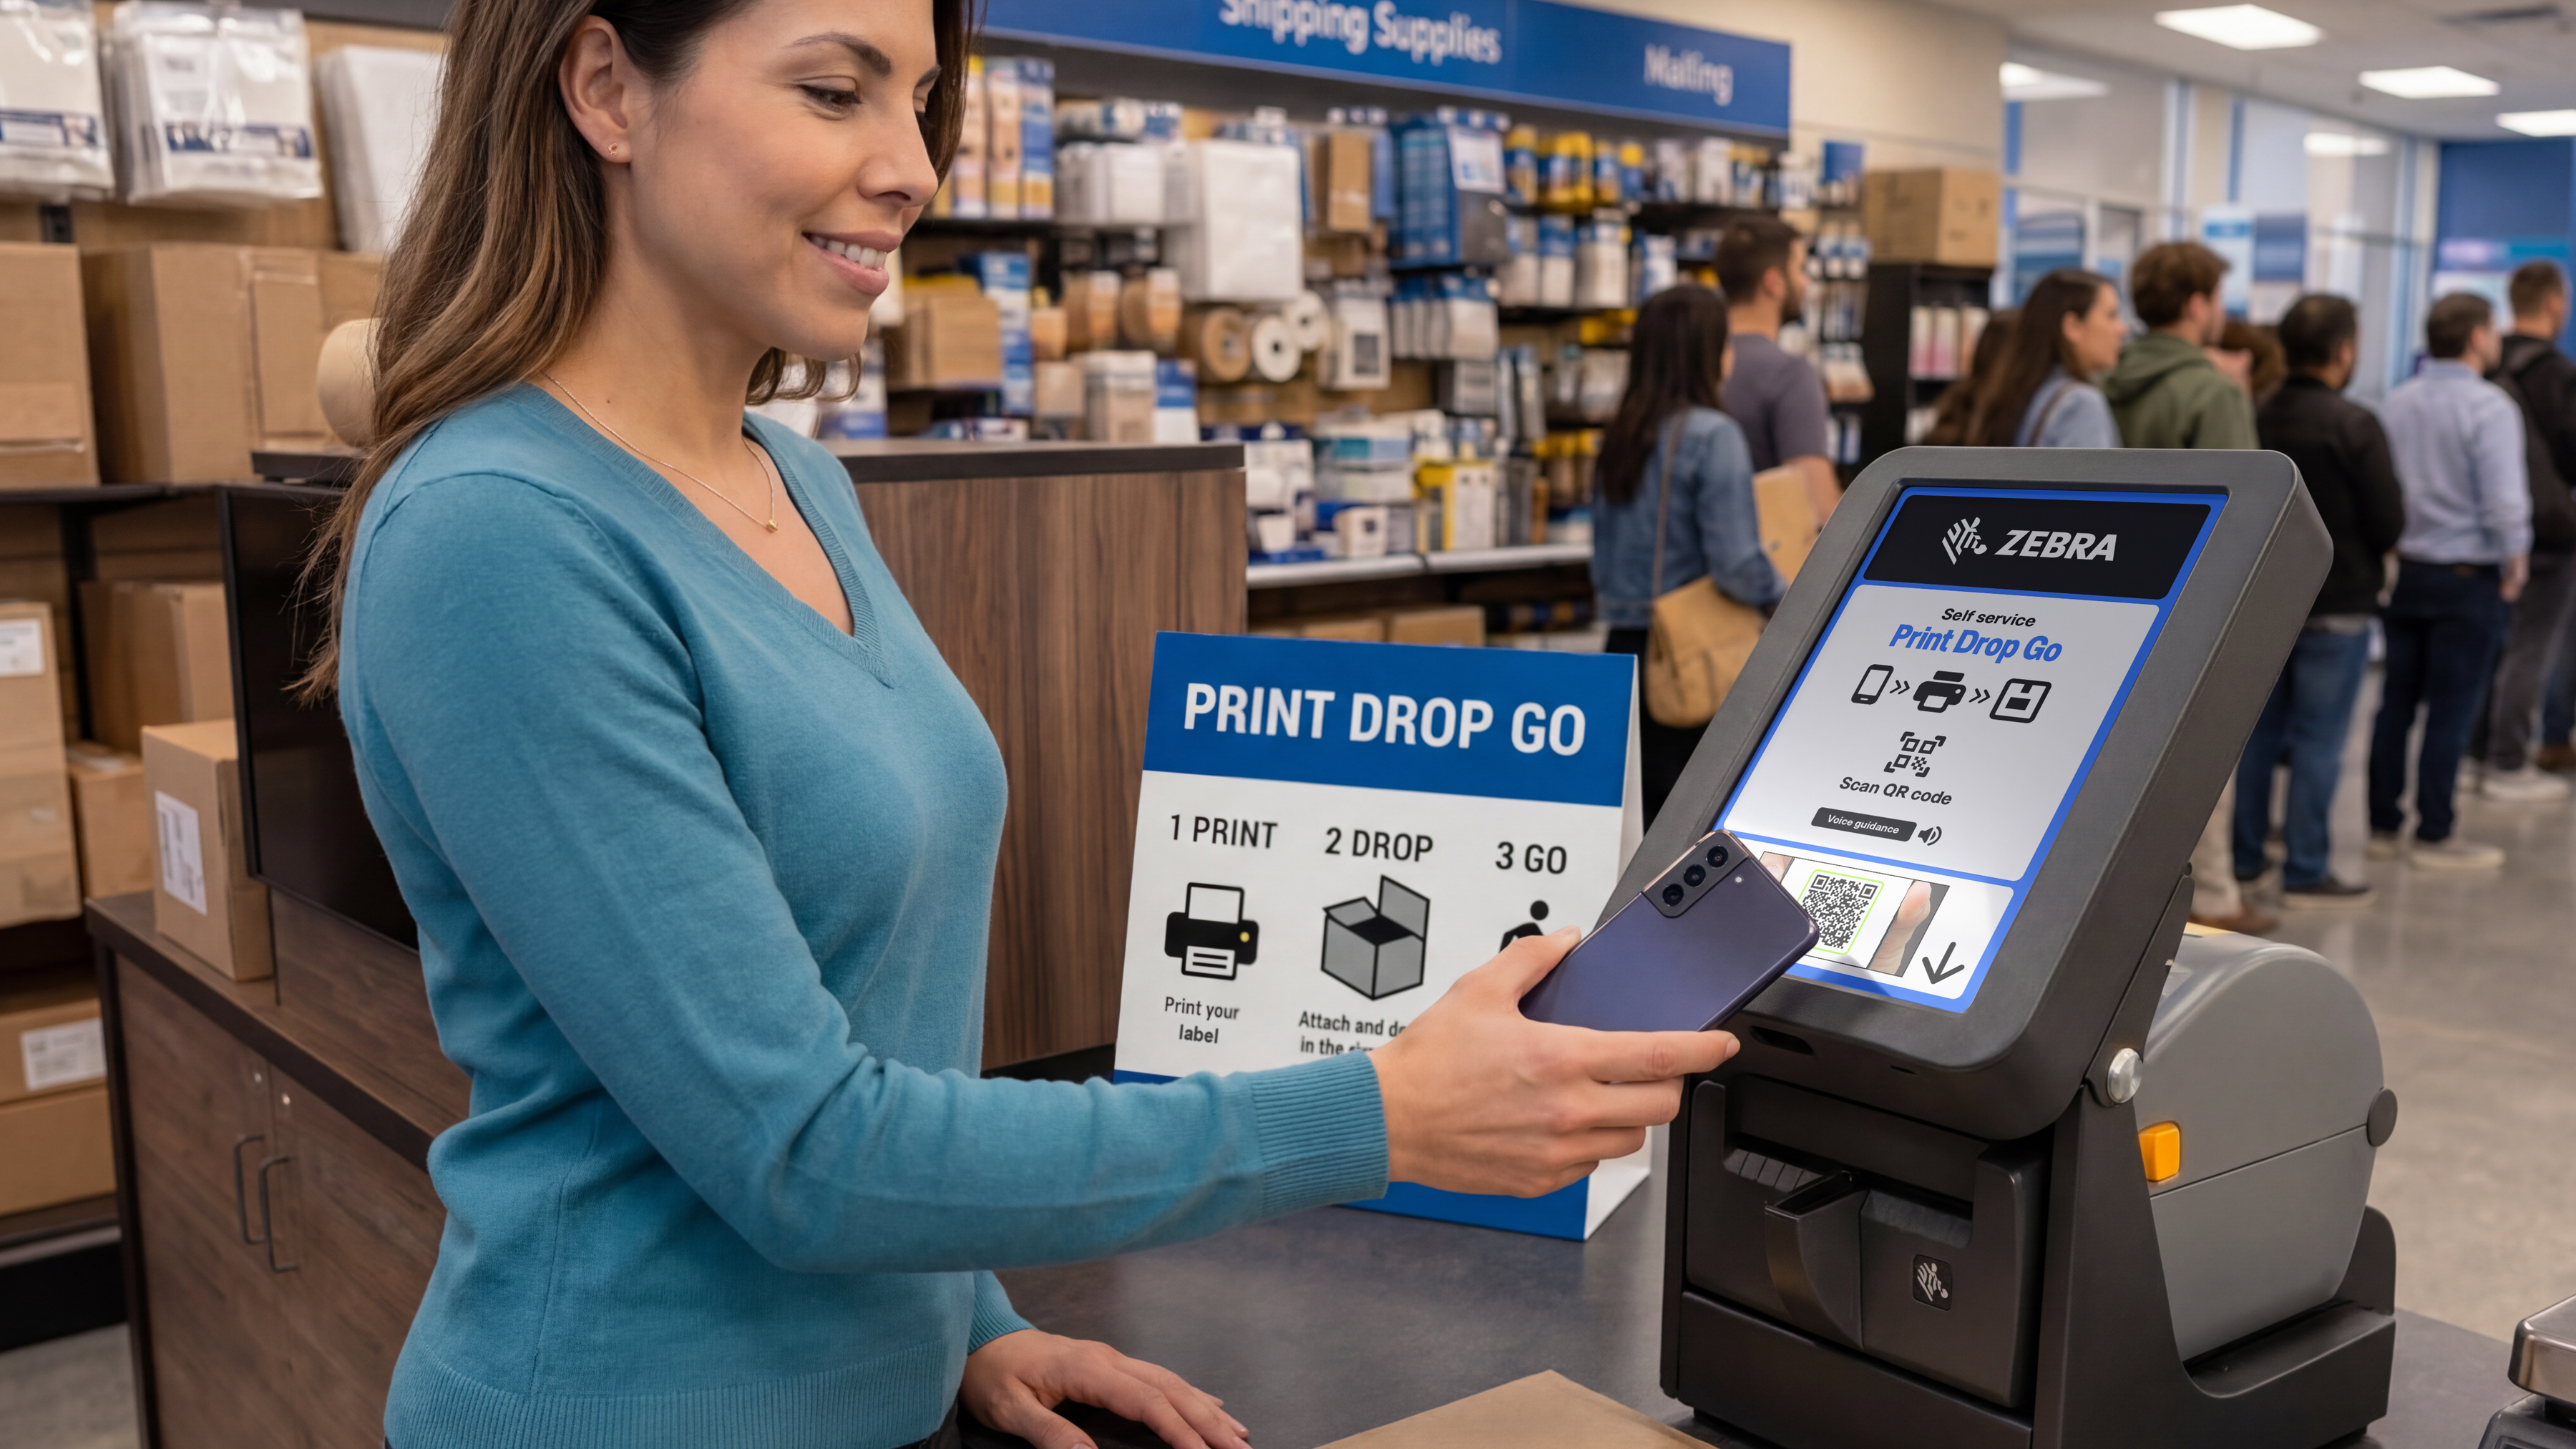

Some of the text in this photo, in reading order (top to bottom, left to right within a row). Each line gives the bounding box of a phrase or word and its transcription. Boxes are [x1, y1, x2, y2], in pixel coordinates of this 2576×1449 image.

[1372, 0, 1502, 66] Supplies
[1994, 530, 2118, 562] ZEBRA
[1941, 608, 2036, 628] Self service
[1888, 623, 2064, 664] Print Drop Go
[1184, 683, 1586, 756] PRINT DROP GO
[1839, 776, 1953, 806] Scan QR code
[1171, 814, 1279, 849] 1 PRINT
[1828, 814, 1901, 835] Voice guidance
[1324, 827, 1433, 862] 2 DROP
[1496, 841, 1568, 875] 3 GO
[1164, 996, 1240, 1021] Print your
[1298, 1010, 1350, 1032] Attach
[1355, 1019, 1385, 1036] and
[1179, 1024, 1219, 1044] label
[1300, 1035, 1314, 1053] in
[1319, 1038, 1345, 1056] the
